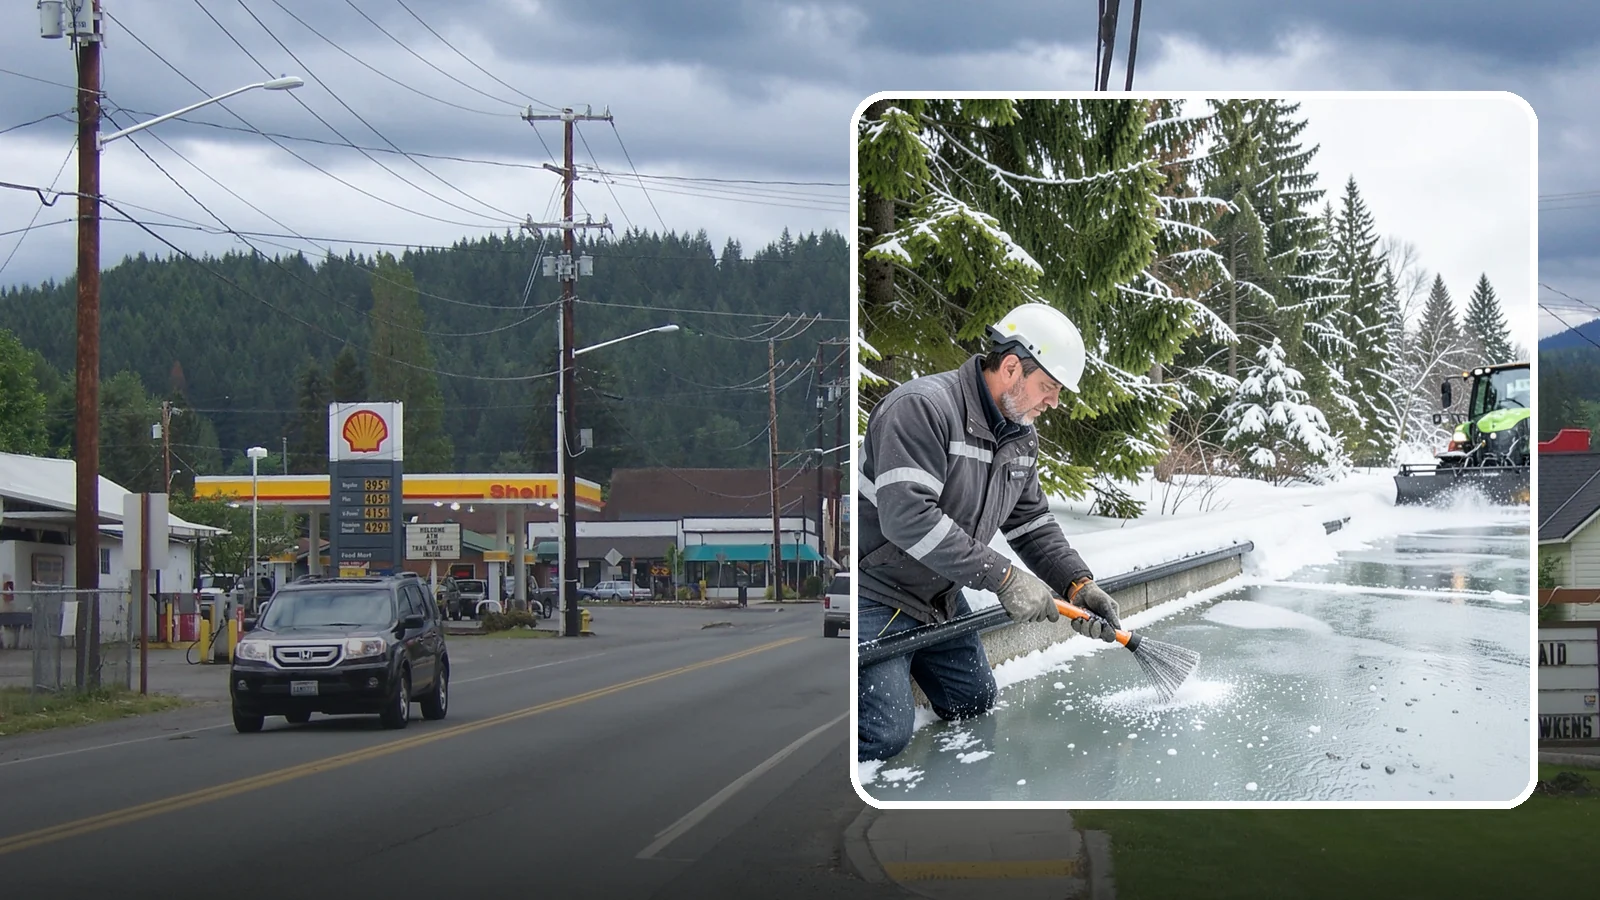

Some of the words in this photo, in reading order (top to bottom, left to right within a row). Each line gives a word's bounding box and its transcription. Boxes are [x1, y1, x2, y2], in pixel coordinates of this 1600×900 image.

[366, 480, 384, 490] 395
[490, 484, 547, 498] Shell
[365, 494, 384, 504] 405
[365, 508, 384, 518] 415
[365, 522, 384, 532] 429
